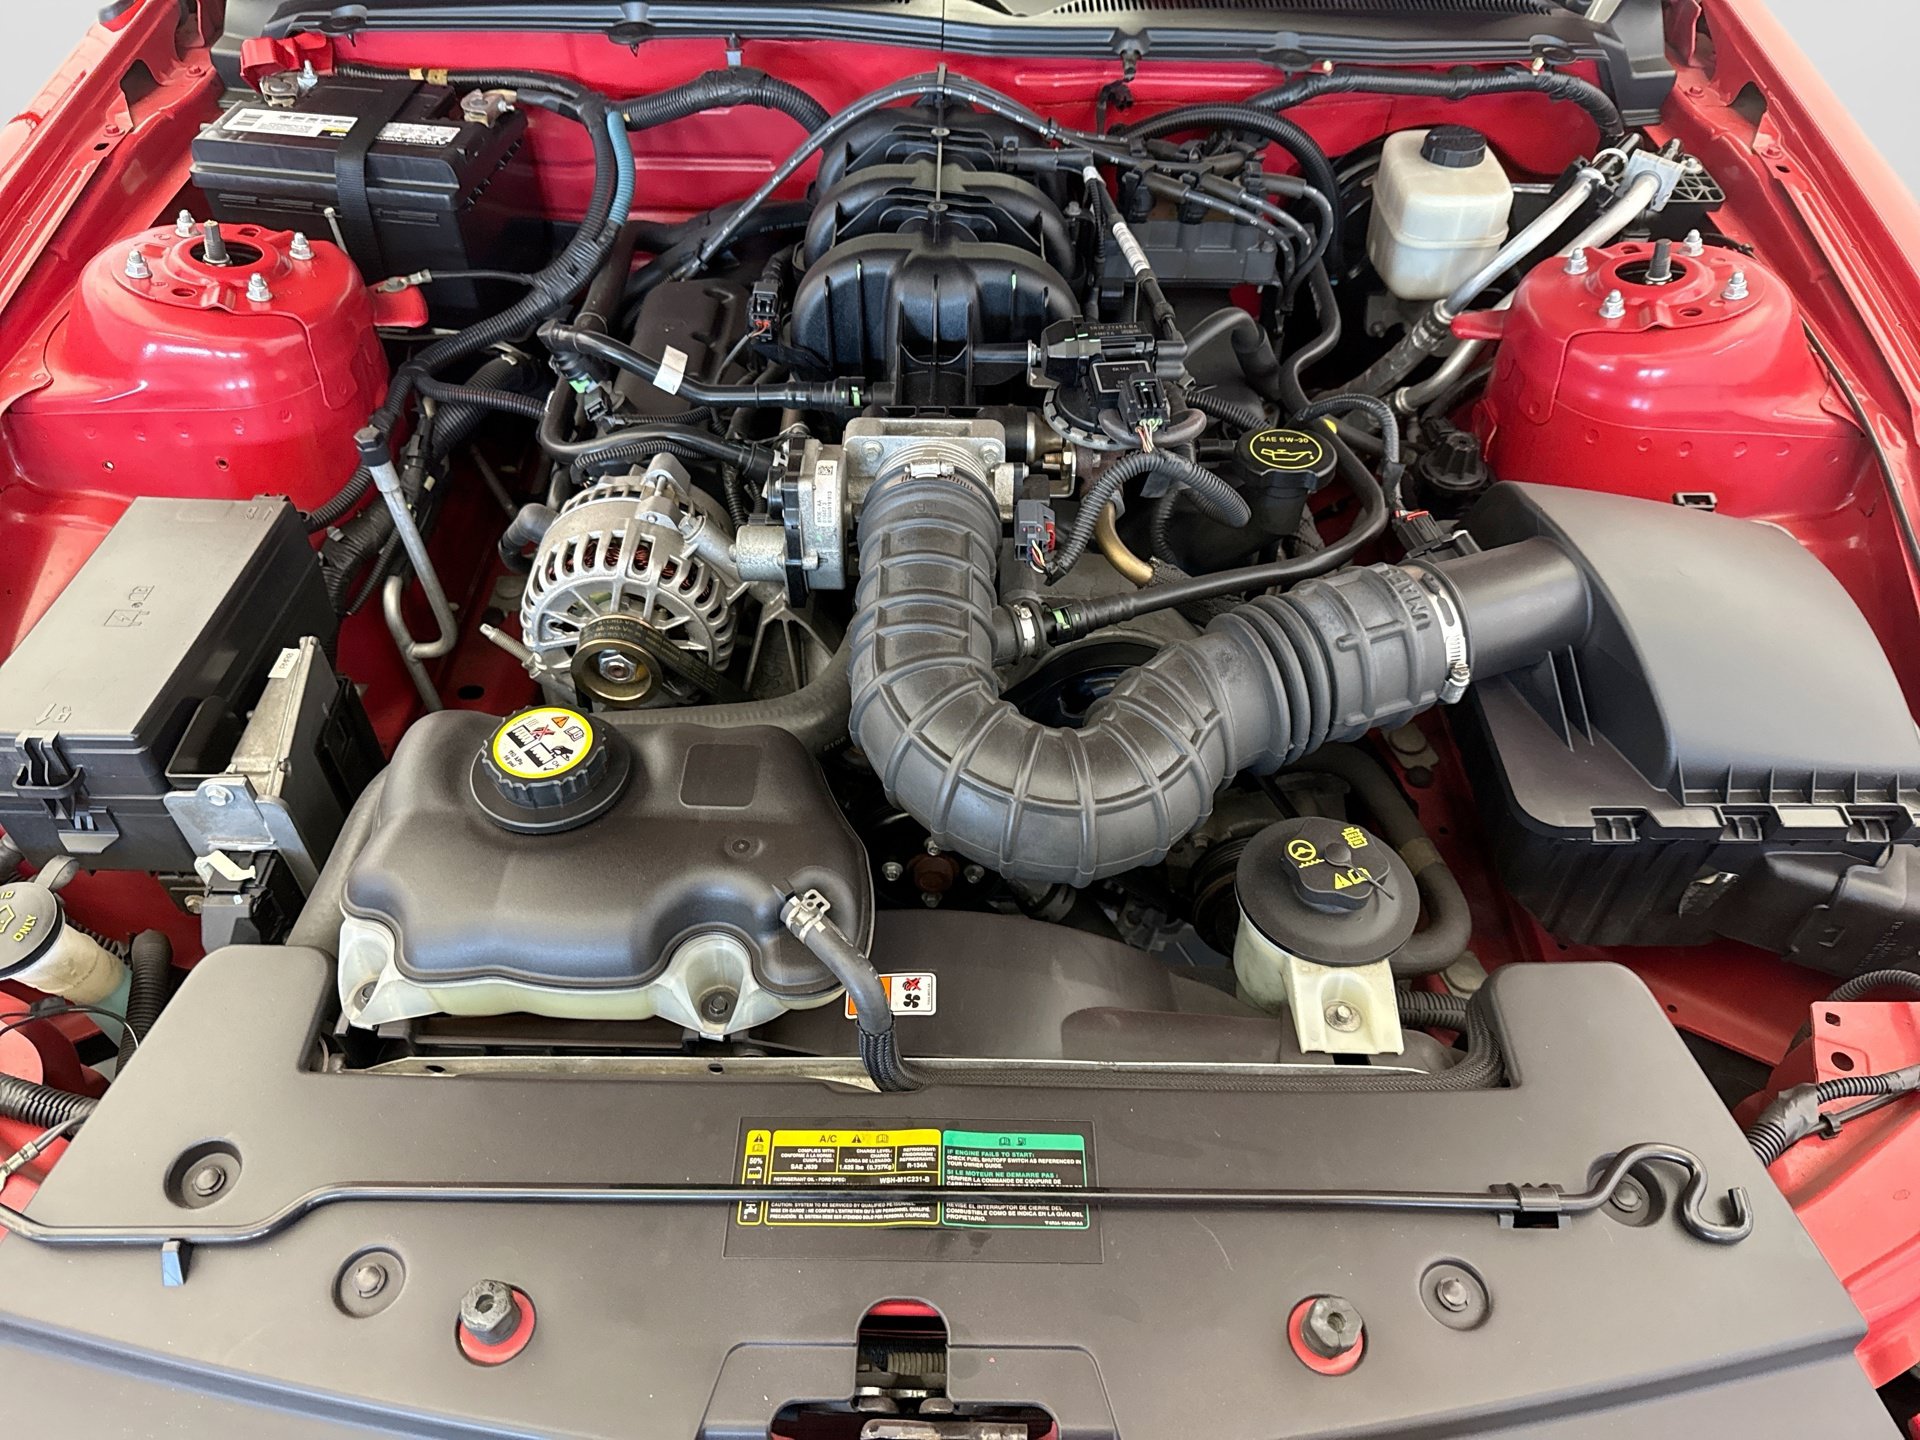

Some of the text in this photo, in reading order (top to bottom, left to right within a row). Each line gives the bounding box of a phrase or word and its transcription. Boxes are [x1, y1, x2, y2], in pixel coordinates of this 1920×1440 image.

[552, 760, 561, 768] OK
[13, 914, 37, 942] ONLY
[819, 1134, 838, 1143] A/C
[749, 1157, 763, 1165] 50%
[880, 1176, 930, 1184] WSH-M1C231-B
[945, 1213, 987, 1222] PROPIETARIO.
